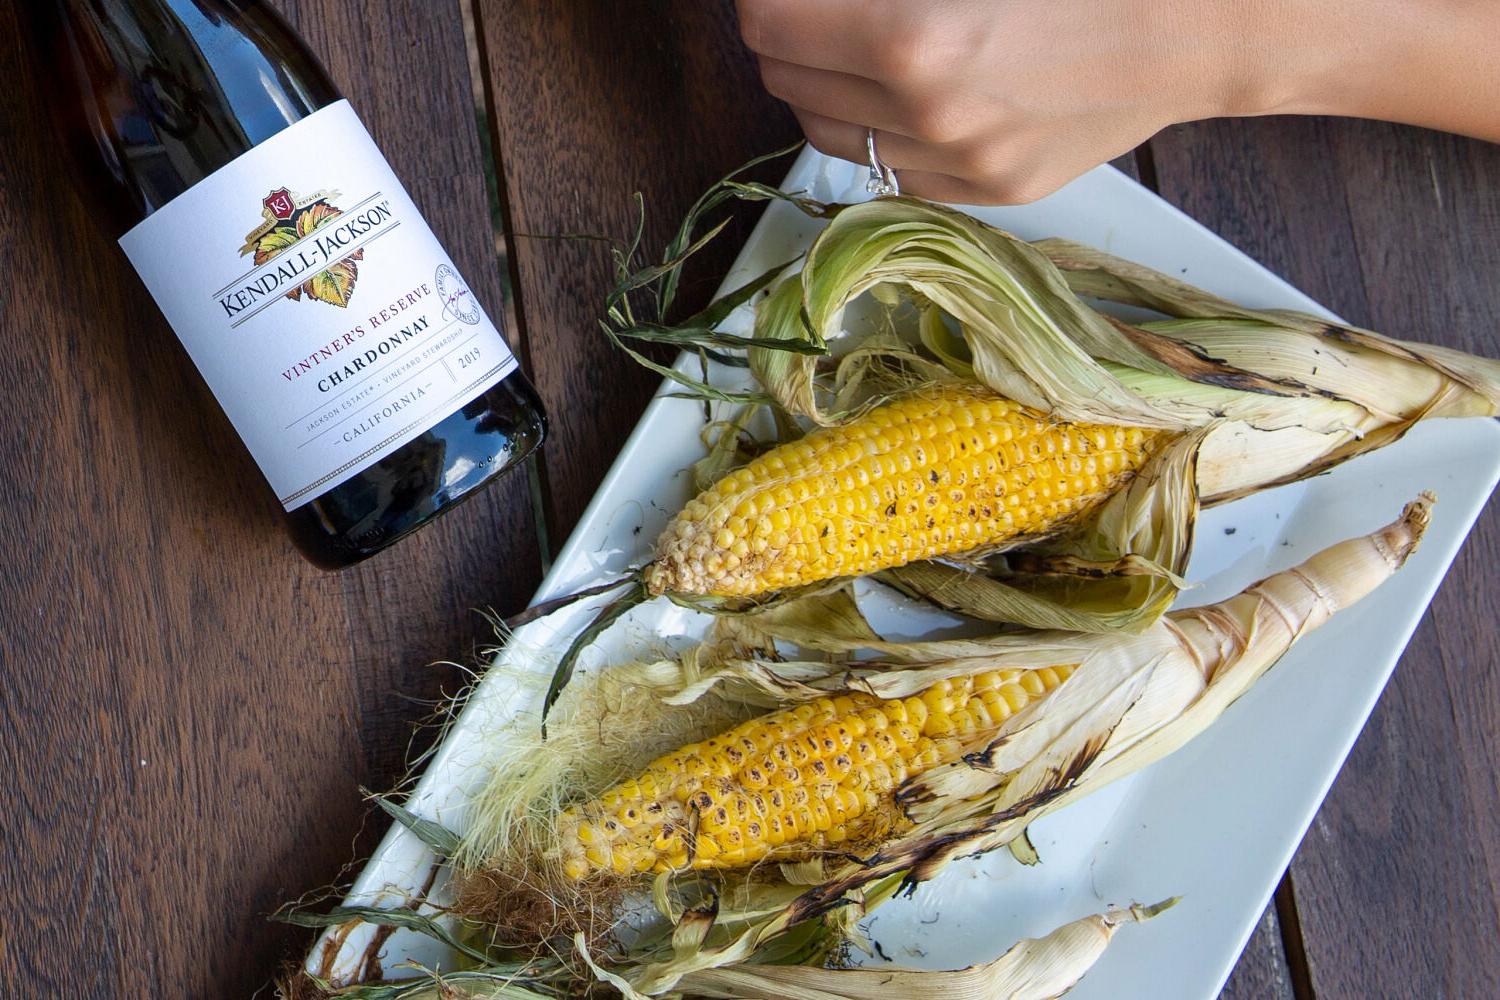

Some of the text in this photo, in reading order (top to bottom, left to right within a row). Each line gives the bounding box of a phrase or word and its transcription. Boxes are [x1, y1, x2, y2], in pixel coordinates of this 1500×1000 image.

[282, 325, 365, 382] VINTNER'S
[369, 283, 431, 330] RESERVE
[317, 315, 430, 393] CHARDONNAY
[458, 347, 482, 369] 2019
[306, 408, 340, 432] JACKSON
[383, 356, 422, 384] VINEYARD
[422, 328, 464, 360] STEWARDSHIP
